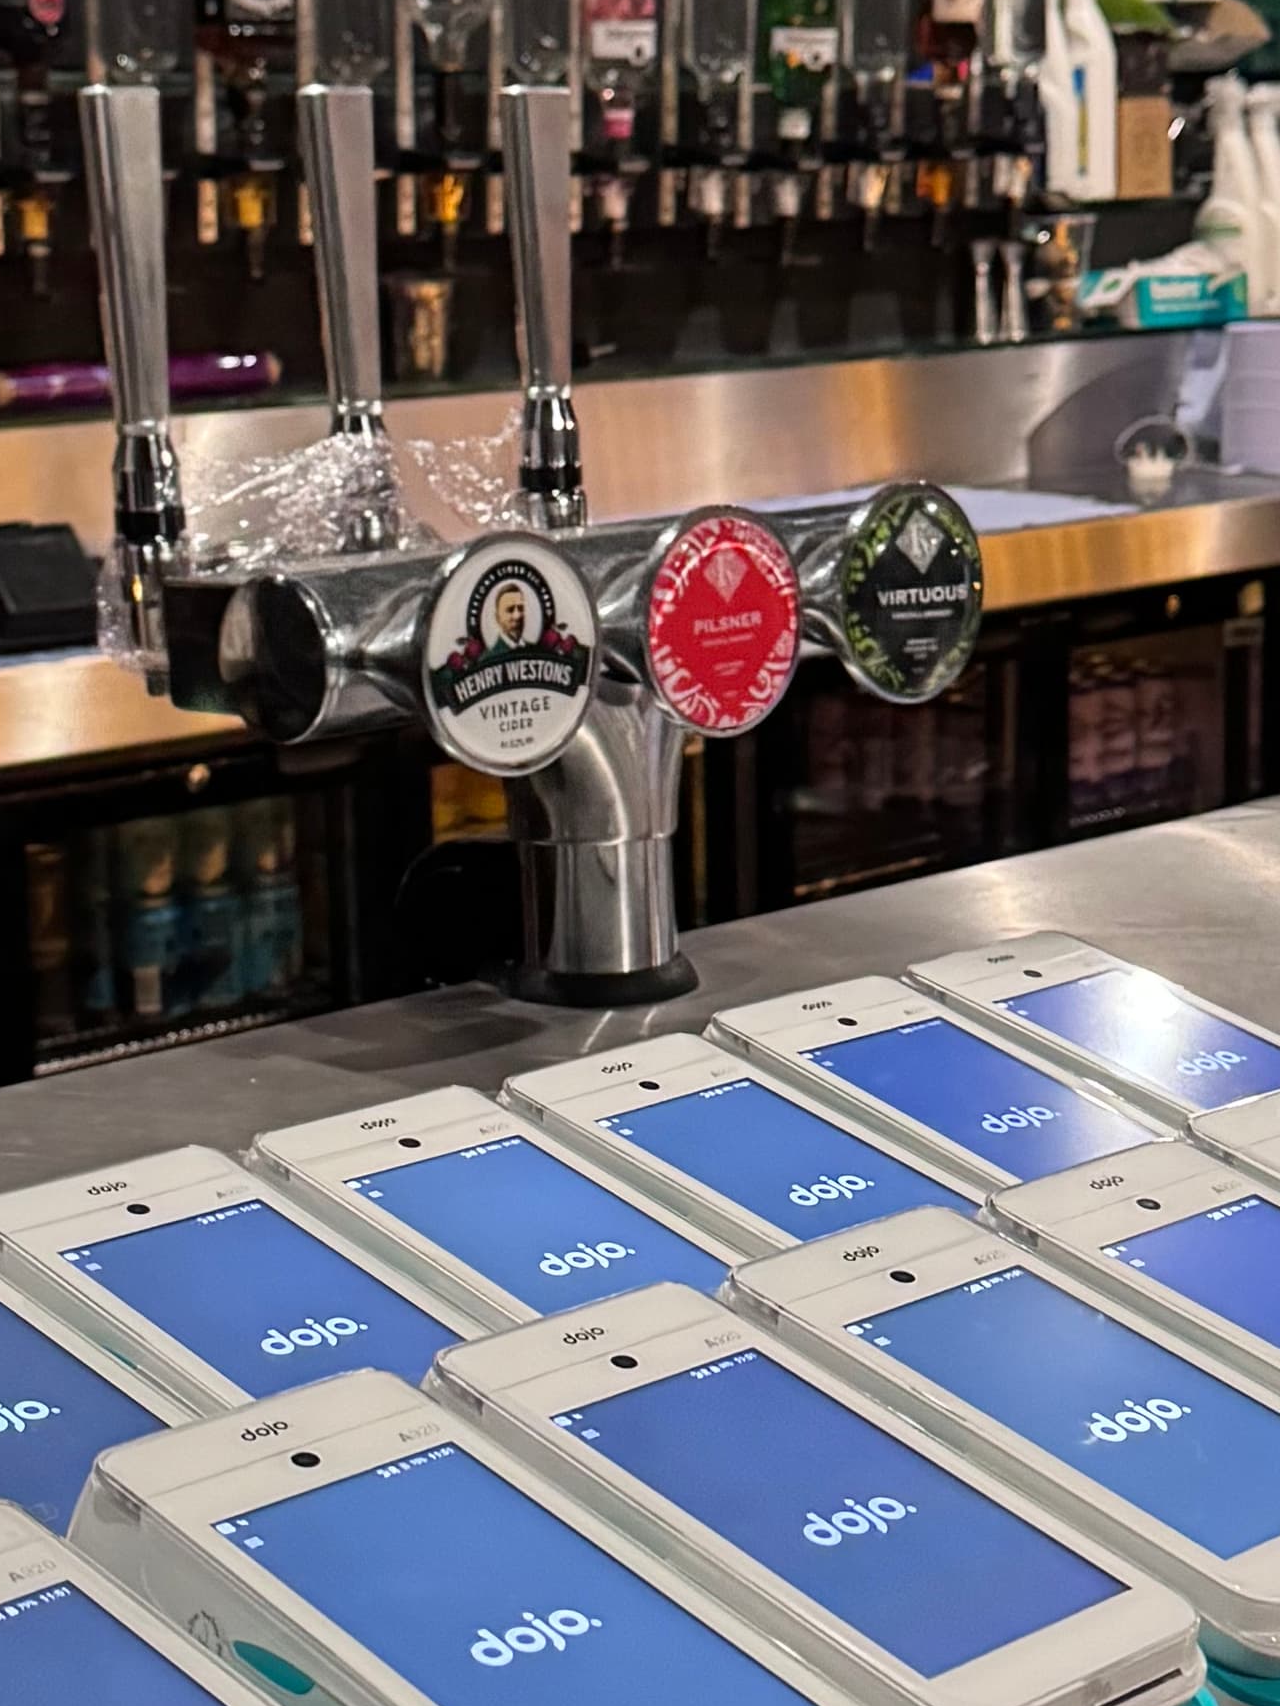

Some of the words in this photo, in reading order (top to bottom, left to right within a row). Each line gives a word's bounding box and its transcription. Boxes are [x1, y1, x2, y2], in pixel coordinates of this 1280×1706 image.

[877, 582, 969, 607] VIRTUOUS
[692, 610, 763, 635] PILSNER
[454, 663, 503, 703] HENRY
[505, 659, 573, 686] WESTONS
[479, 695, 551, 721] VINTAGE
[498, 718, 534, 733] CIDER
[981, 1105, 1062, 1135] dojo.
[789, 1173, 876, 1208] dojo.
[538, 1240, 637, 1277] dojo.
[260, 1316, 369, 1356] dojo.
[1088, 1397, 1192, 1444] dojo.
[803, 1496, 918, 1547] dojo.
[470, 1608, 603, 1667] dojo.
